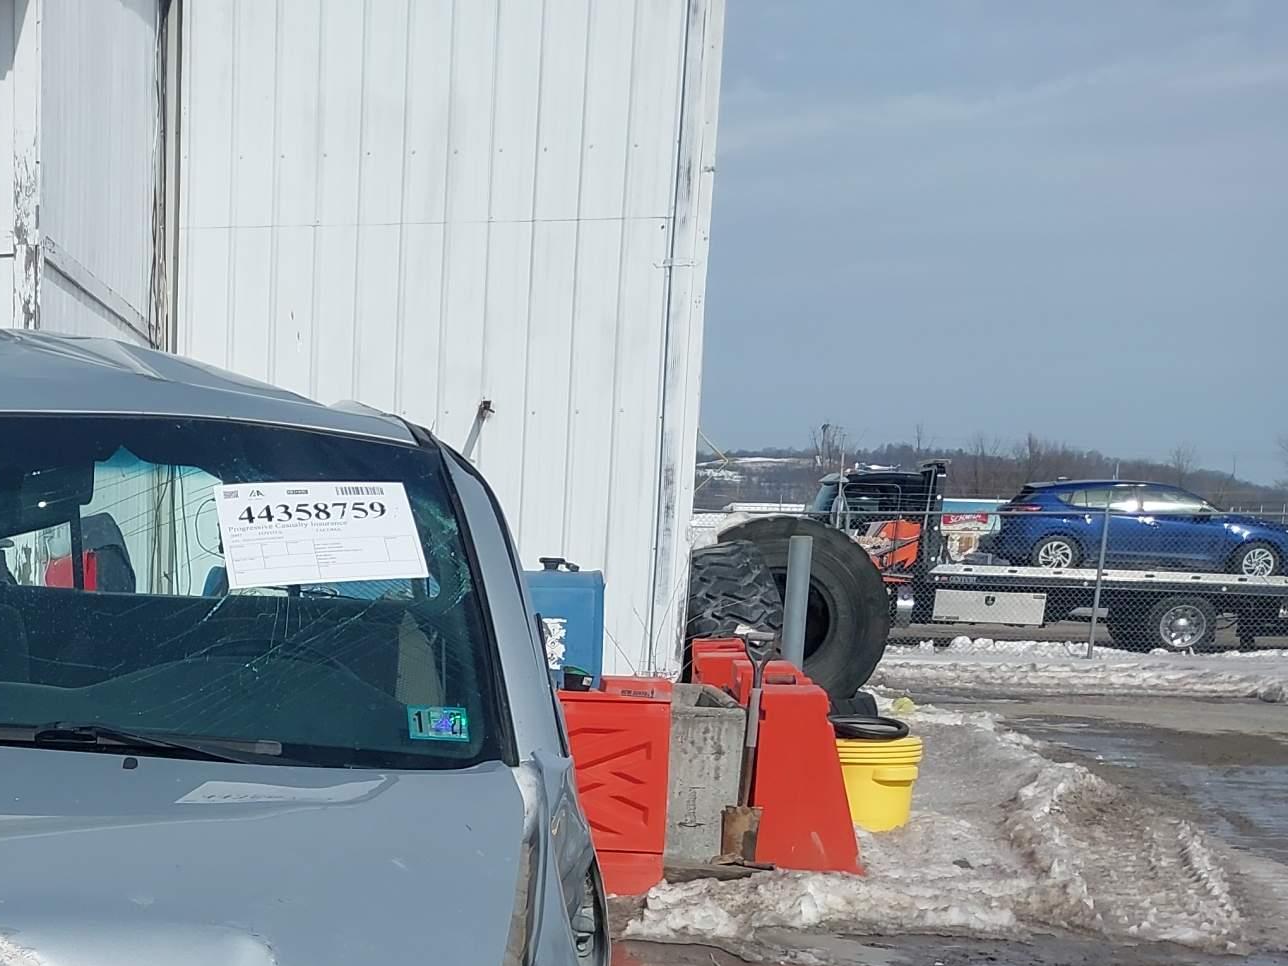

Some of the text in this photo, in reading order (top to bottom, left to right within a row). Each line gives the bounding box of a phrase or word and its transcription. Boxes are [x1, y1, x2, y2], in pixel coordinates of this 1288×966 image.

[238, 501, 386, 523] 44358759
[228, 524, 274, 534] Progressive
[275, 521, 309, 530] Casualty
